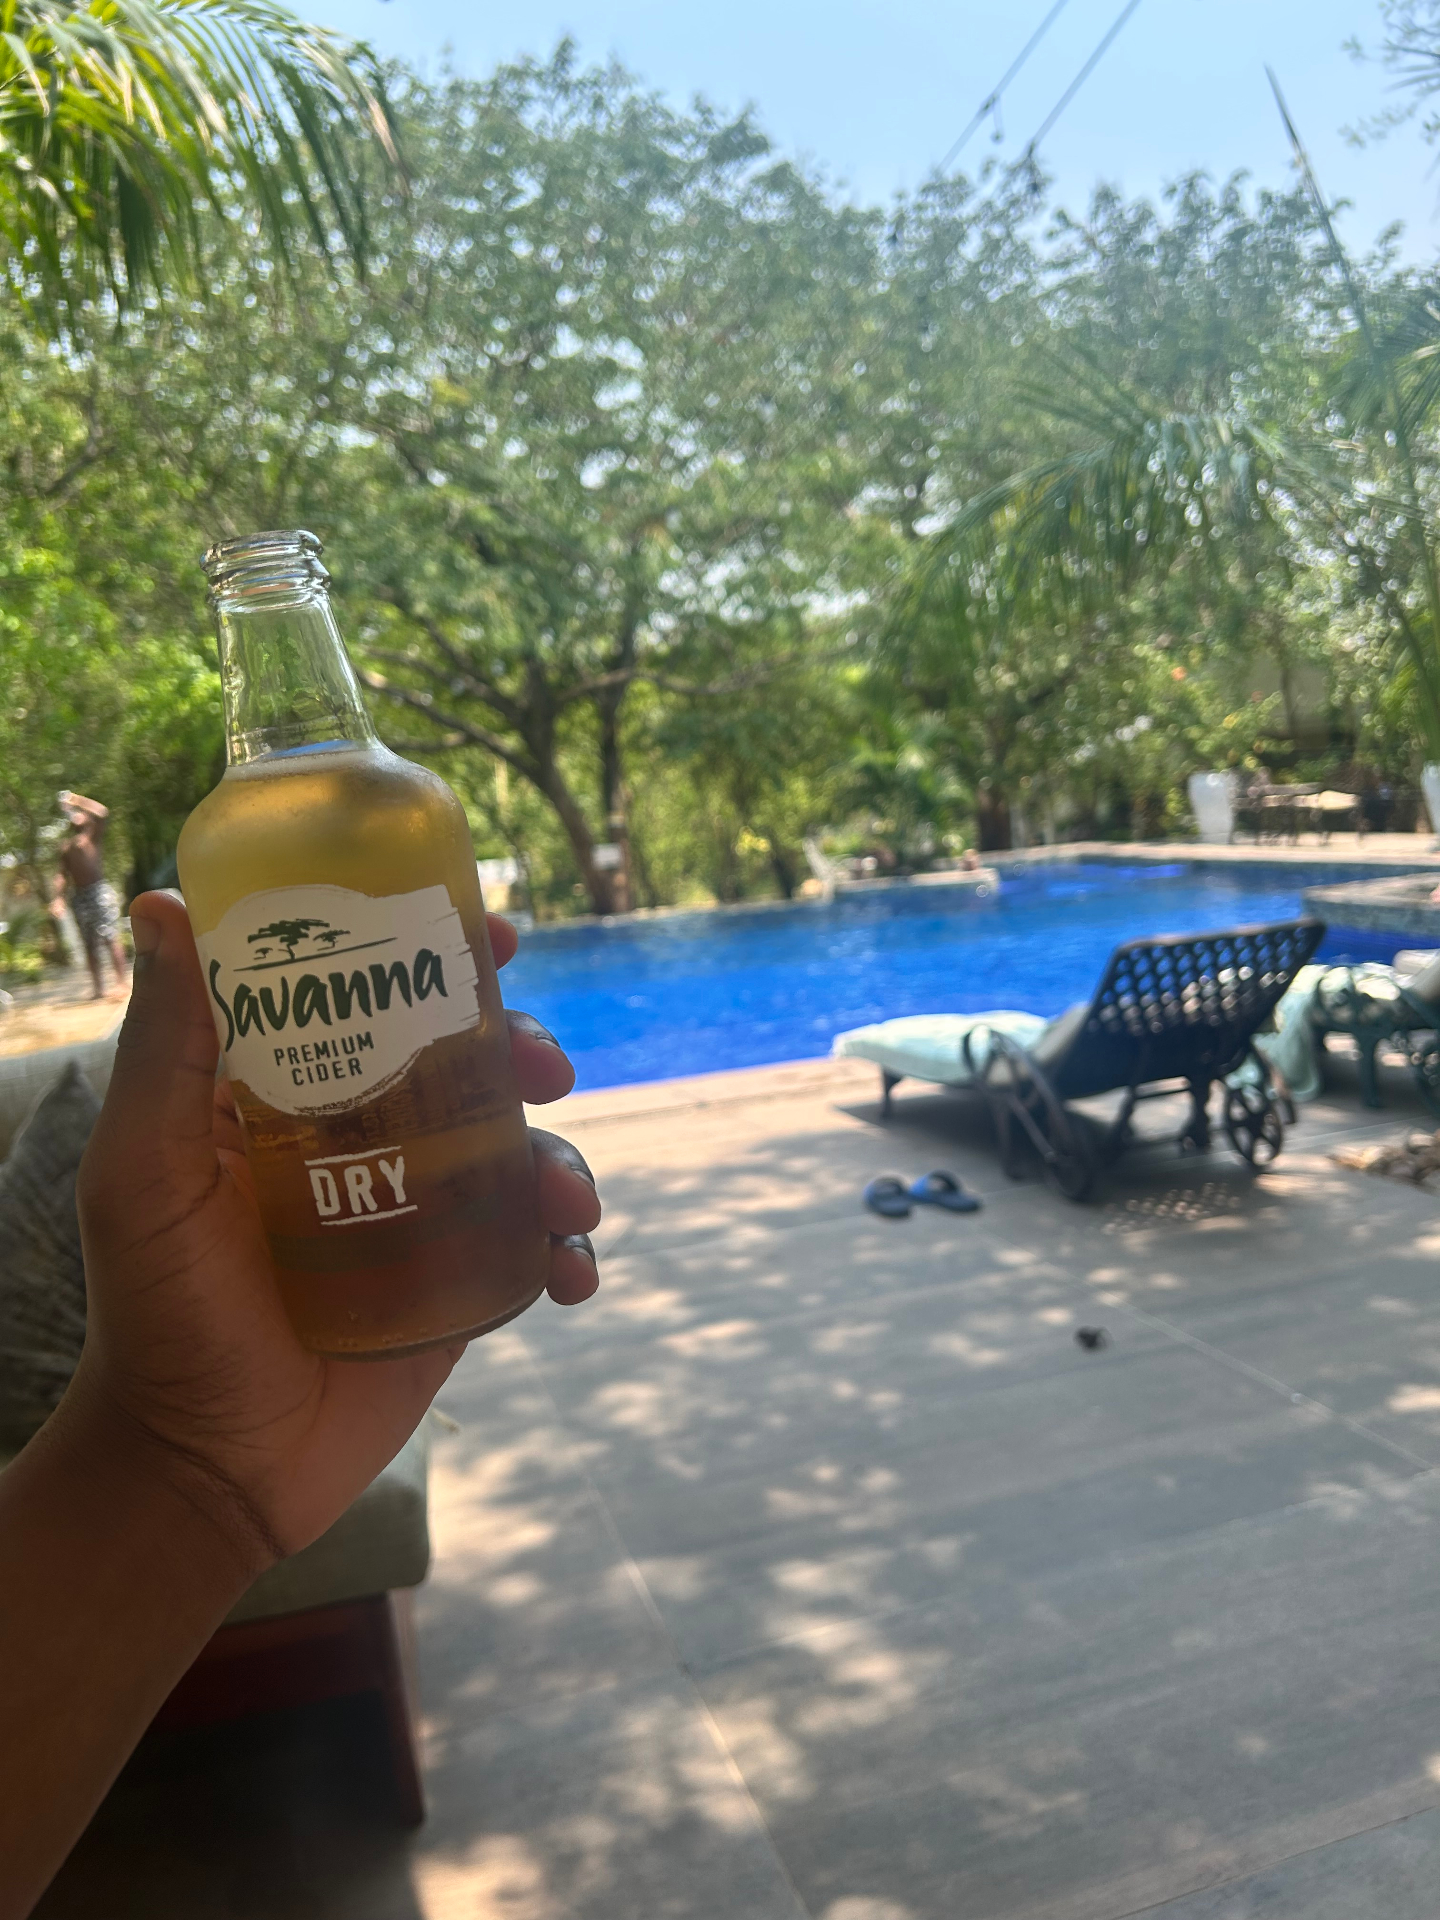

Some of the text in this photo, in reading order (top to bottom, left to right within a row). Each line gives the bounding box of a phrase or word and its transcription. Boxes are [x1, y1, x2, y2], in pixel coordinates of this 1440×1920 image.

[209, 948, 449, 1052] Savanna
[273, 1031, 374, 1066] PREMIUM
[292, 1057, 363, 1086] CIDER
[308, 1155, 407, 1216] DRY
